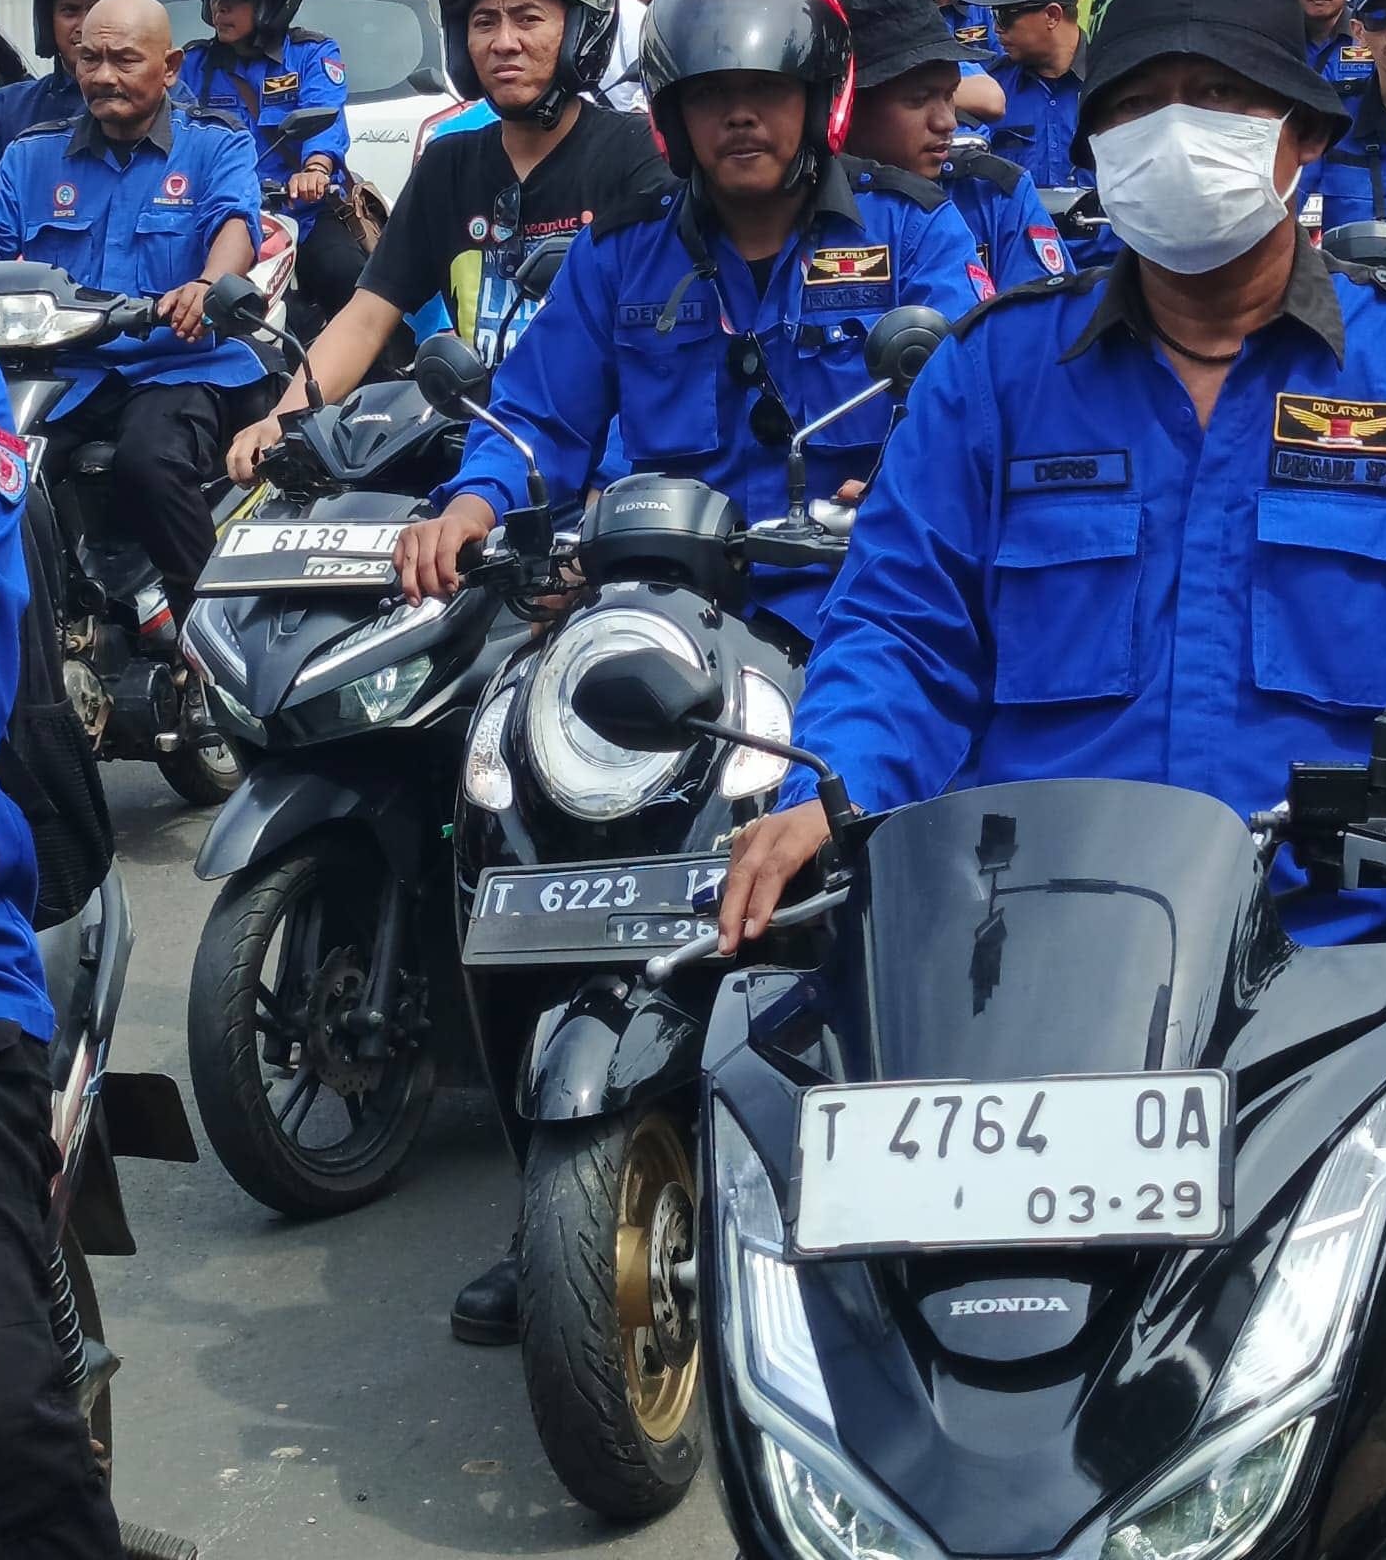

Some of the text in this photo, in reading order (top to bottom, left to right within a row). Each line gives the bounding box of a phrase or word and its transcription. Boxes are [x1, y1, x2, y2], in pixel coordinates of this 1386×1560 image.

[352, 412, 393, 425] HONDA
[1312, 401, 1375, 418] DIKLATSAR
[614, 499, 672, 514] HONDA
[232, 528, 251, 553] T
[272, 528, 349, 553] 6139
[493, 883, 514, 914] T
[538, 874, 641, 913] 6223
[817, 1101, 847, 1161] T
[888, 1090, 1049, 1160] 4764
[949, 1295, 1071, 1316] HONDA
